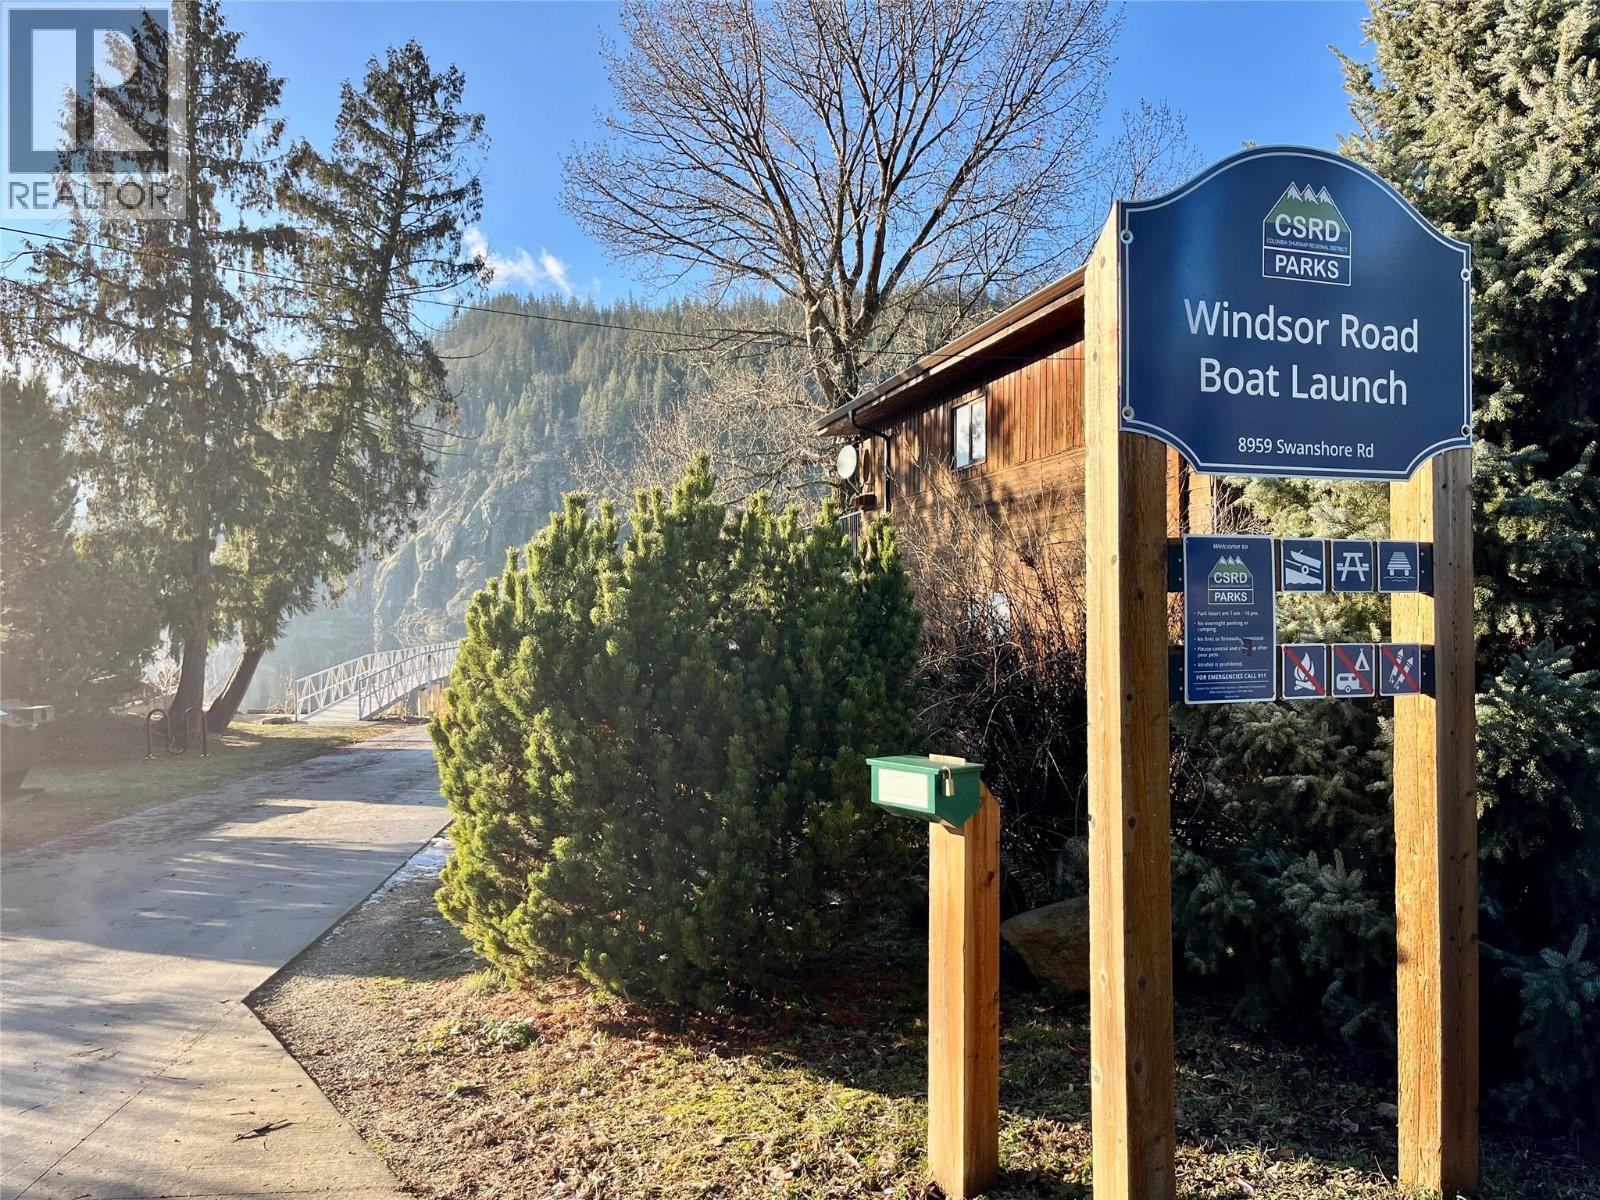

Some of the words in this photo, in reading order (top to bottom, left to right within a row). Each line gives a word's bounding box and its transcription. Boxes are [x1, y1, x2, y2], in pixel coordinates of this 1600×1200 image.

[1275, 213, 1341, 242] CSRD
[1309, 242, 1329, 250] REGIONAL
[1275, 254, 1339, 279] PARKS
[1183, 298, 1330, 345] Windsor
[1340, 313, 1419, 353] Road
[1200, 357, 1280, 398] Boat
[1292, 364, 1407, 405] Launch
[1238, 437, 1273, 454] 8959
[1276, 439, 1352, 457] Swanshore
[1357, 443, 1374, 458] Rd
[1213, 571, 1248, 584] CSRD
[1214, 591, 1248, 602] PARKS
